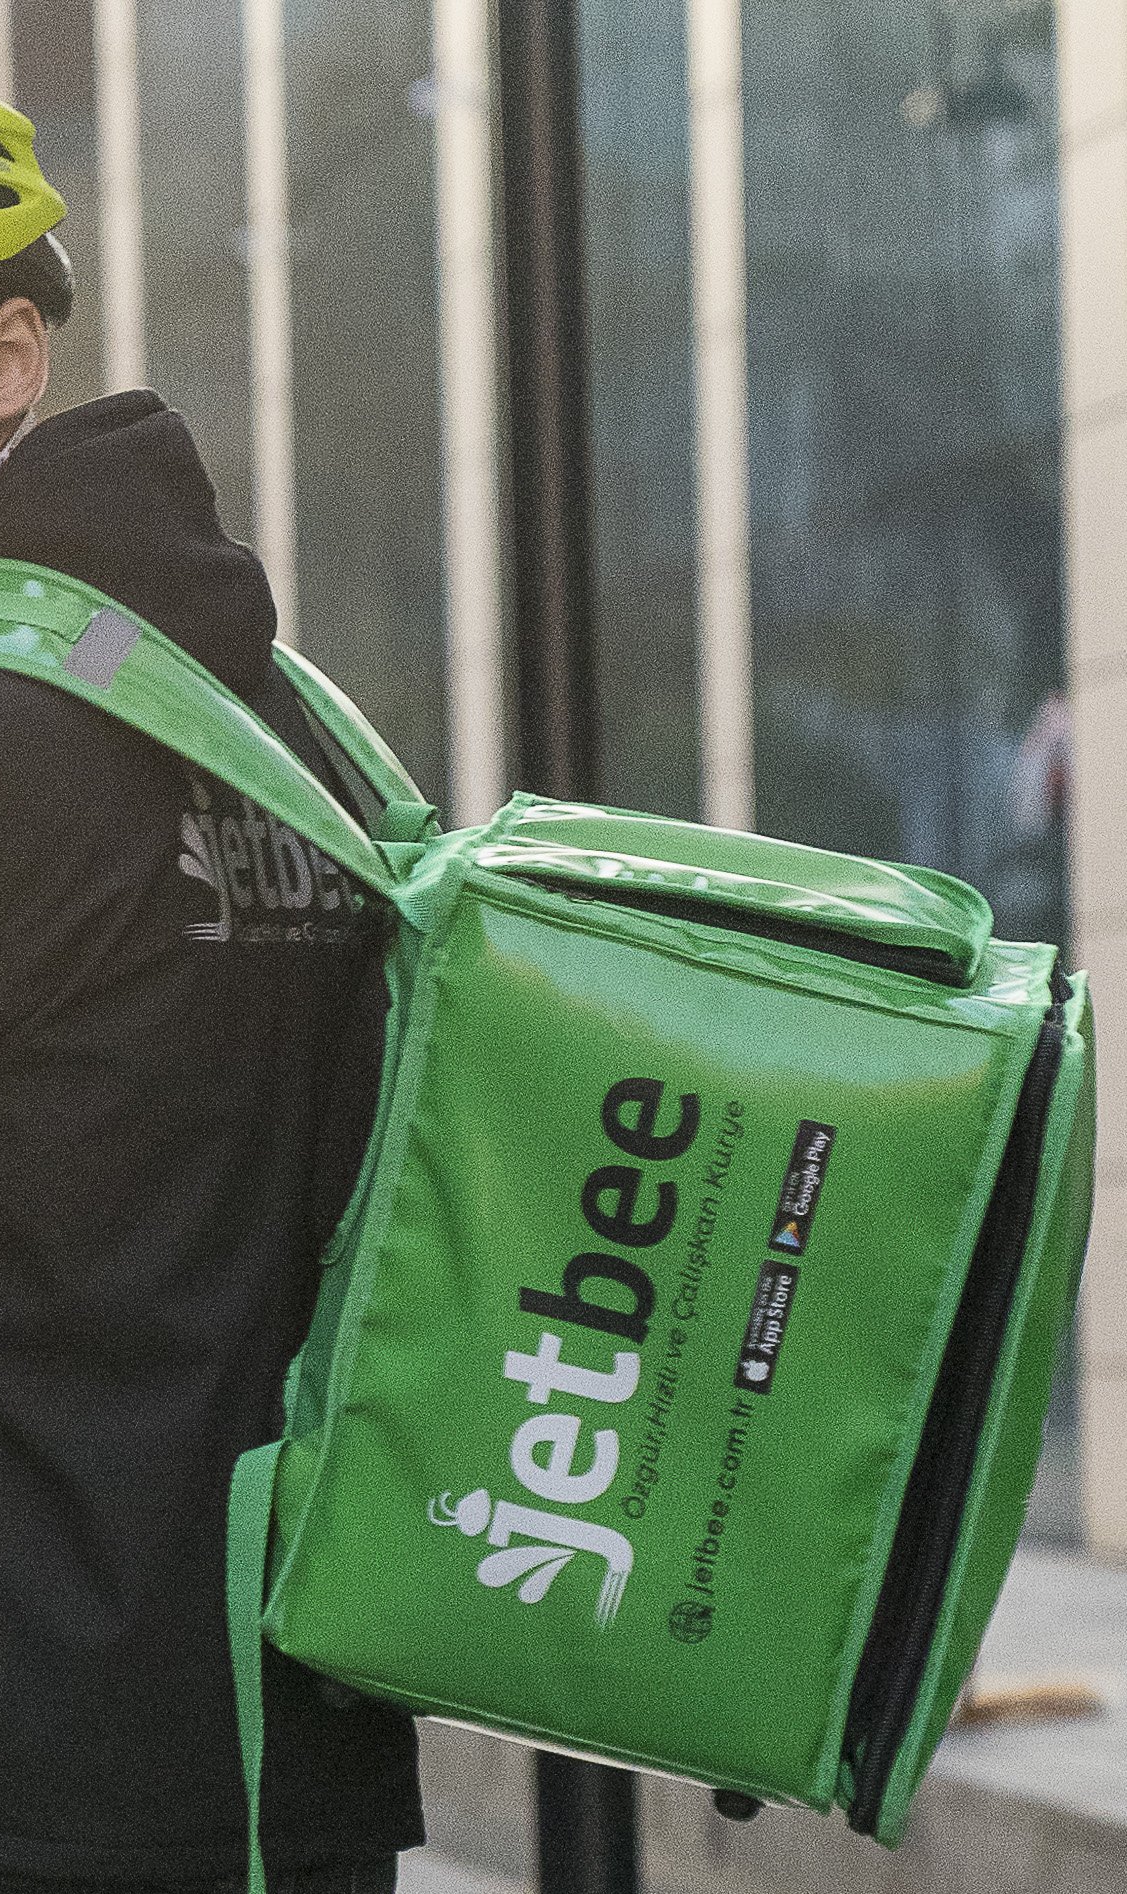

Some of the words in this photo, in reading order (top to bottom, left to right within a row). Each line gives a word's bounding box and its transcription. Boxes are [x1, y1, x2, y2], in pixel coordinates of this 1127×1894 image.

[194, 781, 365, 941] jetbe
[703, 1099, 744, 1190] Kurye
[804, 1131, 831, 1162] Play
[793, 1163, 821, 1216] Google
[673, 1197, 720, 1321] Çalışkan
[455, 1077, 701, 1575] jetbee
[768, 1275, 792, 1319] Store
[668, 1328, 688, 1361] ve
[759, 1319, 783, 1354] App
[685, 1399, 754, 1595] jetbee.com.tr
